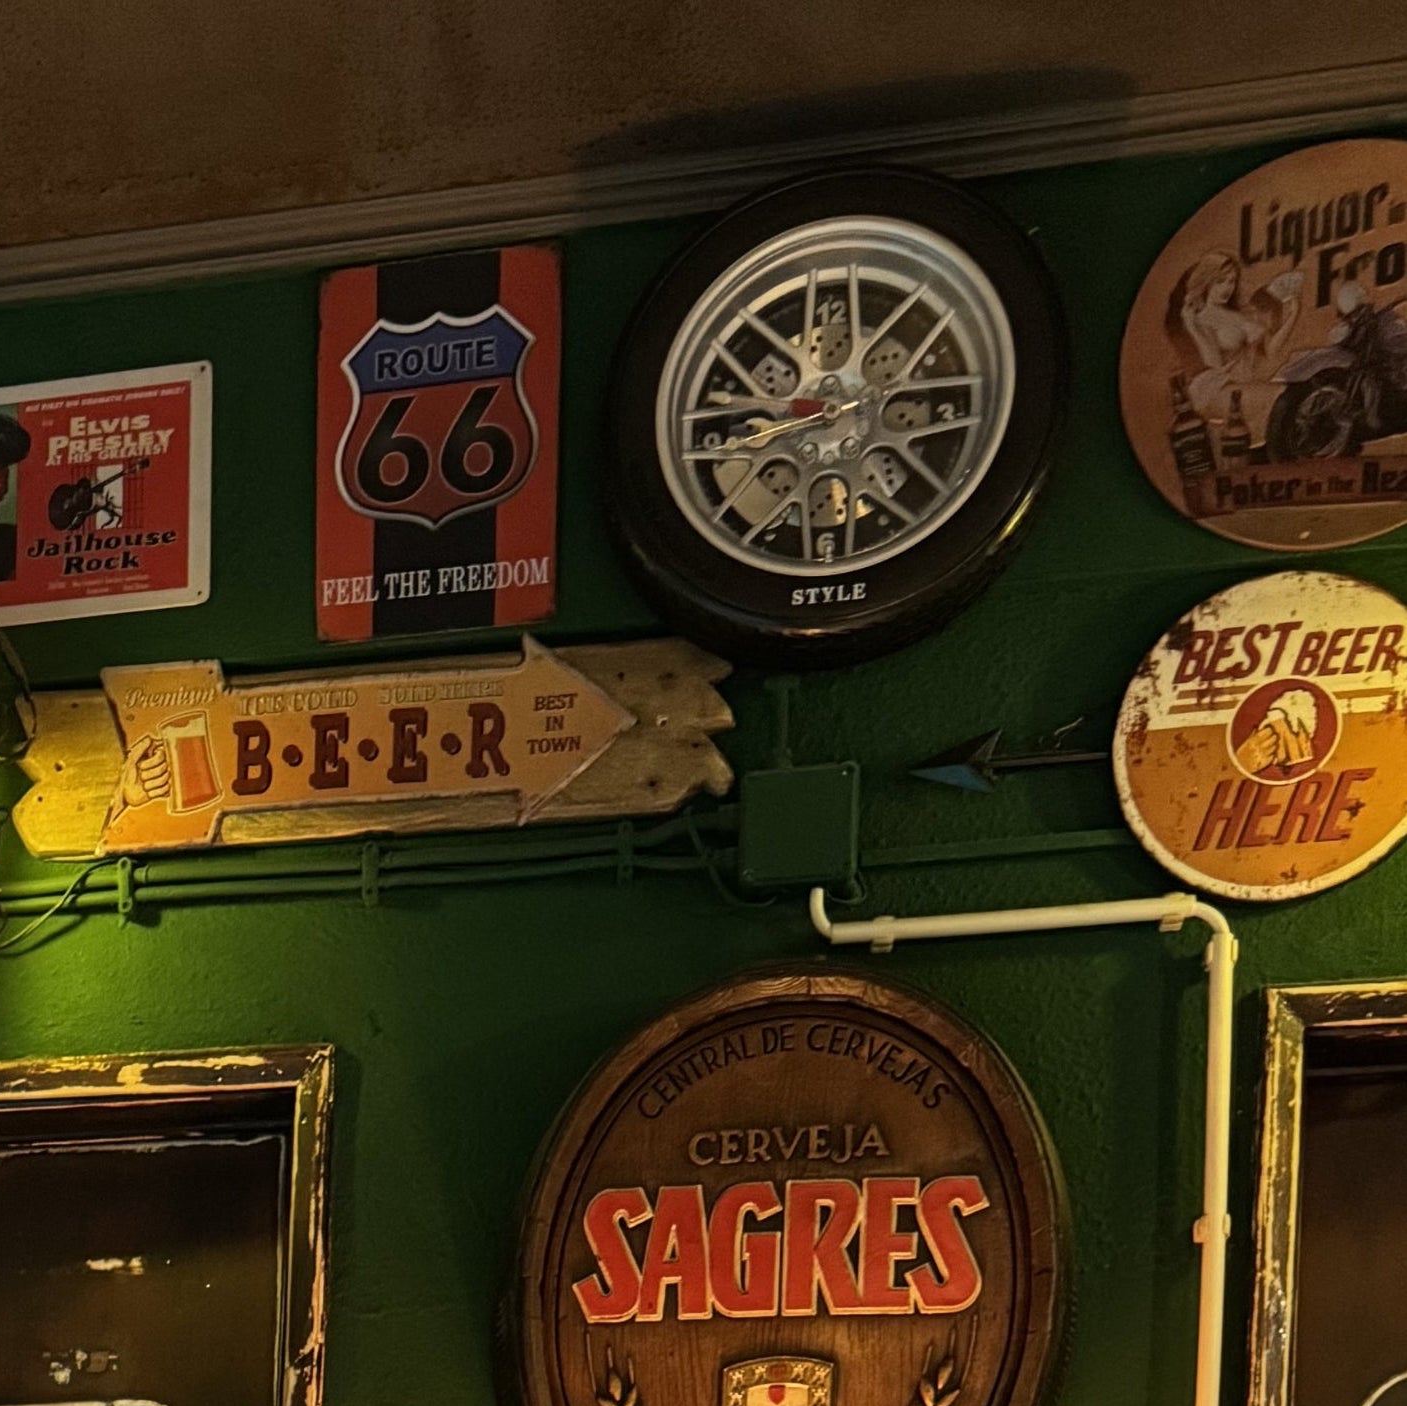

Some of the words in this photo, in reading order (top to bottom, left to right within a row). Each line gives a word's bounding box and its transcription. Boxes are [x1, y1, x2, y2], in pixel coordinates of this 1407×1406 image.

[1239, 181, 1390, 271] Liquor
[815, 300, 846, 323] 12
[375, 338, 496, 381] ROUTE
[70, 414, 151, 437] ELVIS
[936, 403, 956, 421] 3
[48, 428, 175, 458] PRESLEY
[355, 384, 516, 506] 66
[27, 529, 177, 557] Jailhouse
[63, 551, 139, 575] Rock
[321, 576, 380, 606] FEEL
[384, 569, 431, 600] THE
[437, 556, 550, 595] FREEDOM
[791, 582, 867, 605] STYLE
[1172, 621, 1303, 685] BEST
[1291, 624, 1405, 677] BEER
[124, 686, 216, 708] Premium
[289, 689, 358, 712] COLD
[533, 693, 578, 712] BEST
[545, 715, 565, 732] IN
[526, 735, 581, 755] TOWN
[1192, 767, 1377, 851] HERE
[637, 1033, 756, 1119] CENTRAL
[762, 1024, 794, 1055] DE
[807, 1024, 950, 1109] CERVEJAS
[688, 1123, 891, 1166] CERVEJA
[572, 1174, 991, 1325] SAGRES
